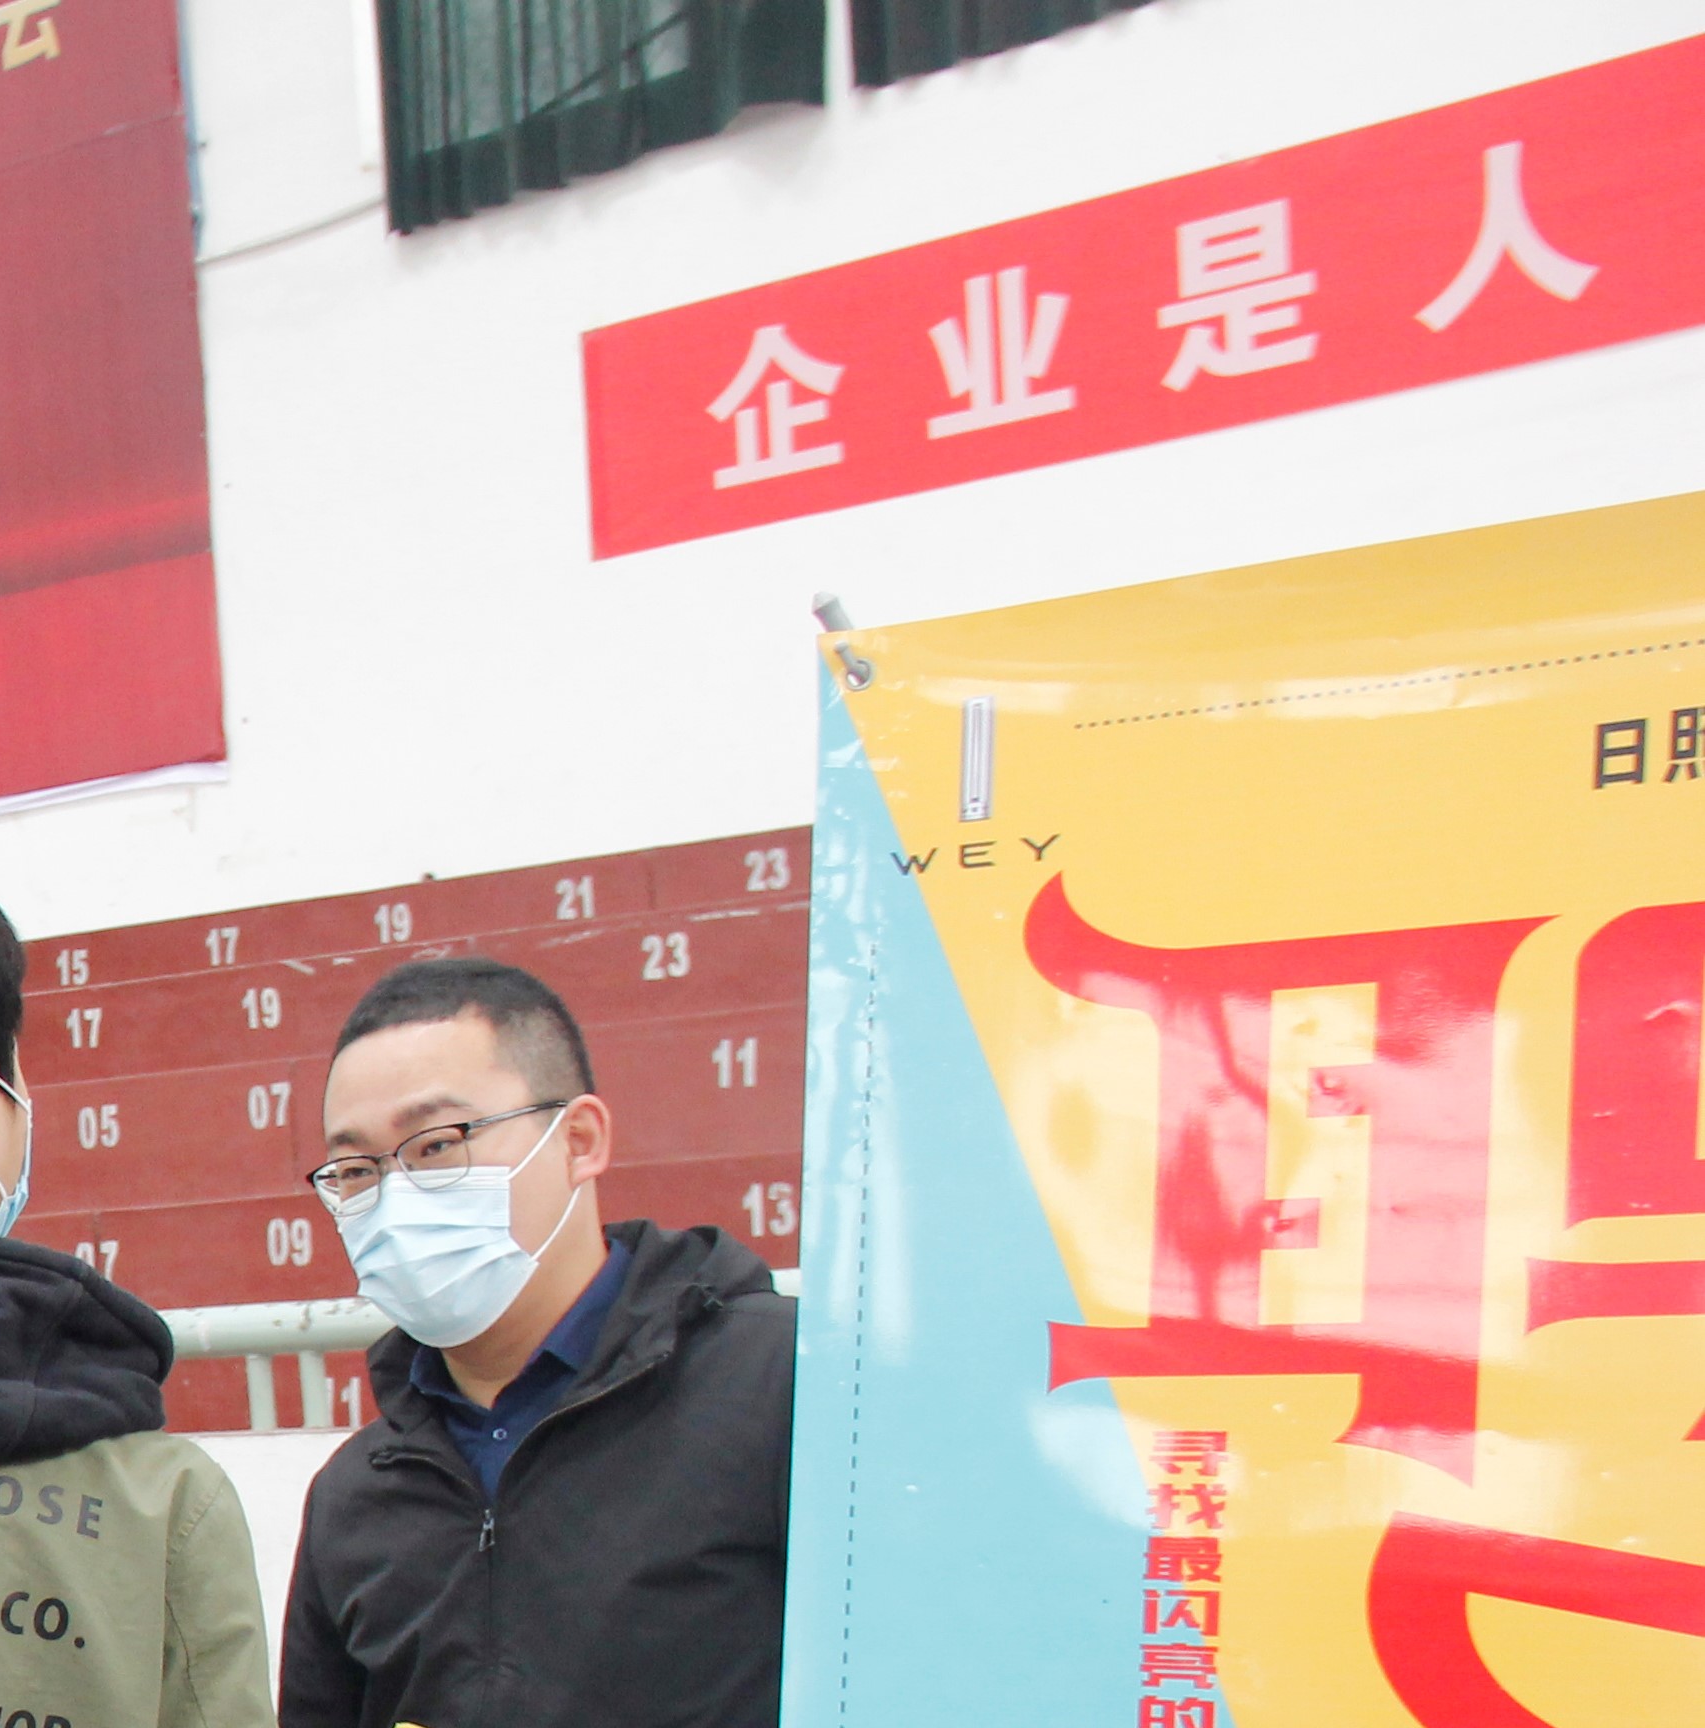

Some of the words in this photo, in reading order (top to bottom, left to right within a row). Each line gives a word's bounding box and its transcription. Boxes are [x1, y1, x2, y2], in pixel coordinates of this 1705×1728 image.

[705, 140, 1601, 490] 企业是人
[890, 834, 1060, 876] WEY
[55, 948, 90, 987] 15
[204, 926, 240, 967] 17
[373, 902, 413, 944] 19
[555, 875, 595, 921] 21
[743, 847, 790, 892] 23
[65, 1007, 103, 1049] 17
[240, 987, 282, 1030] 19
[640, 931, 691, 982] 23
[76, 1103, 121, 1150] 05
[246, 1082, 292, 1131] 07
[710, 1037, 759, 1090] 11
[265, 1217, 313, 1268] 09
